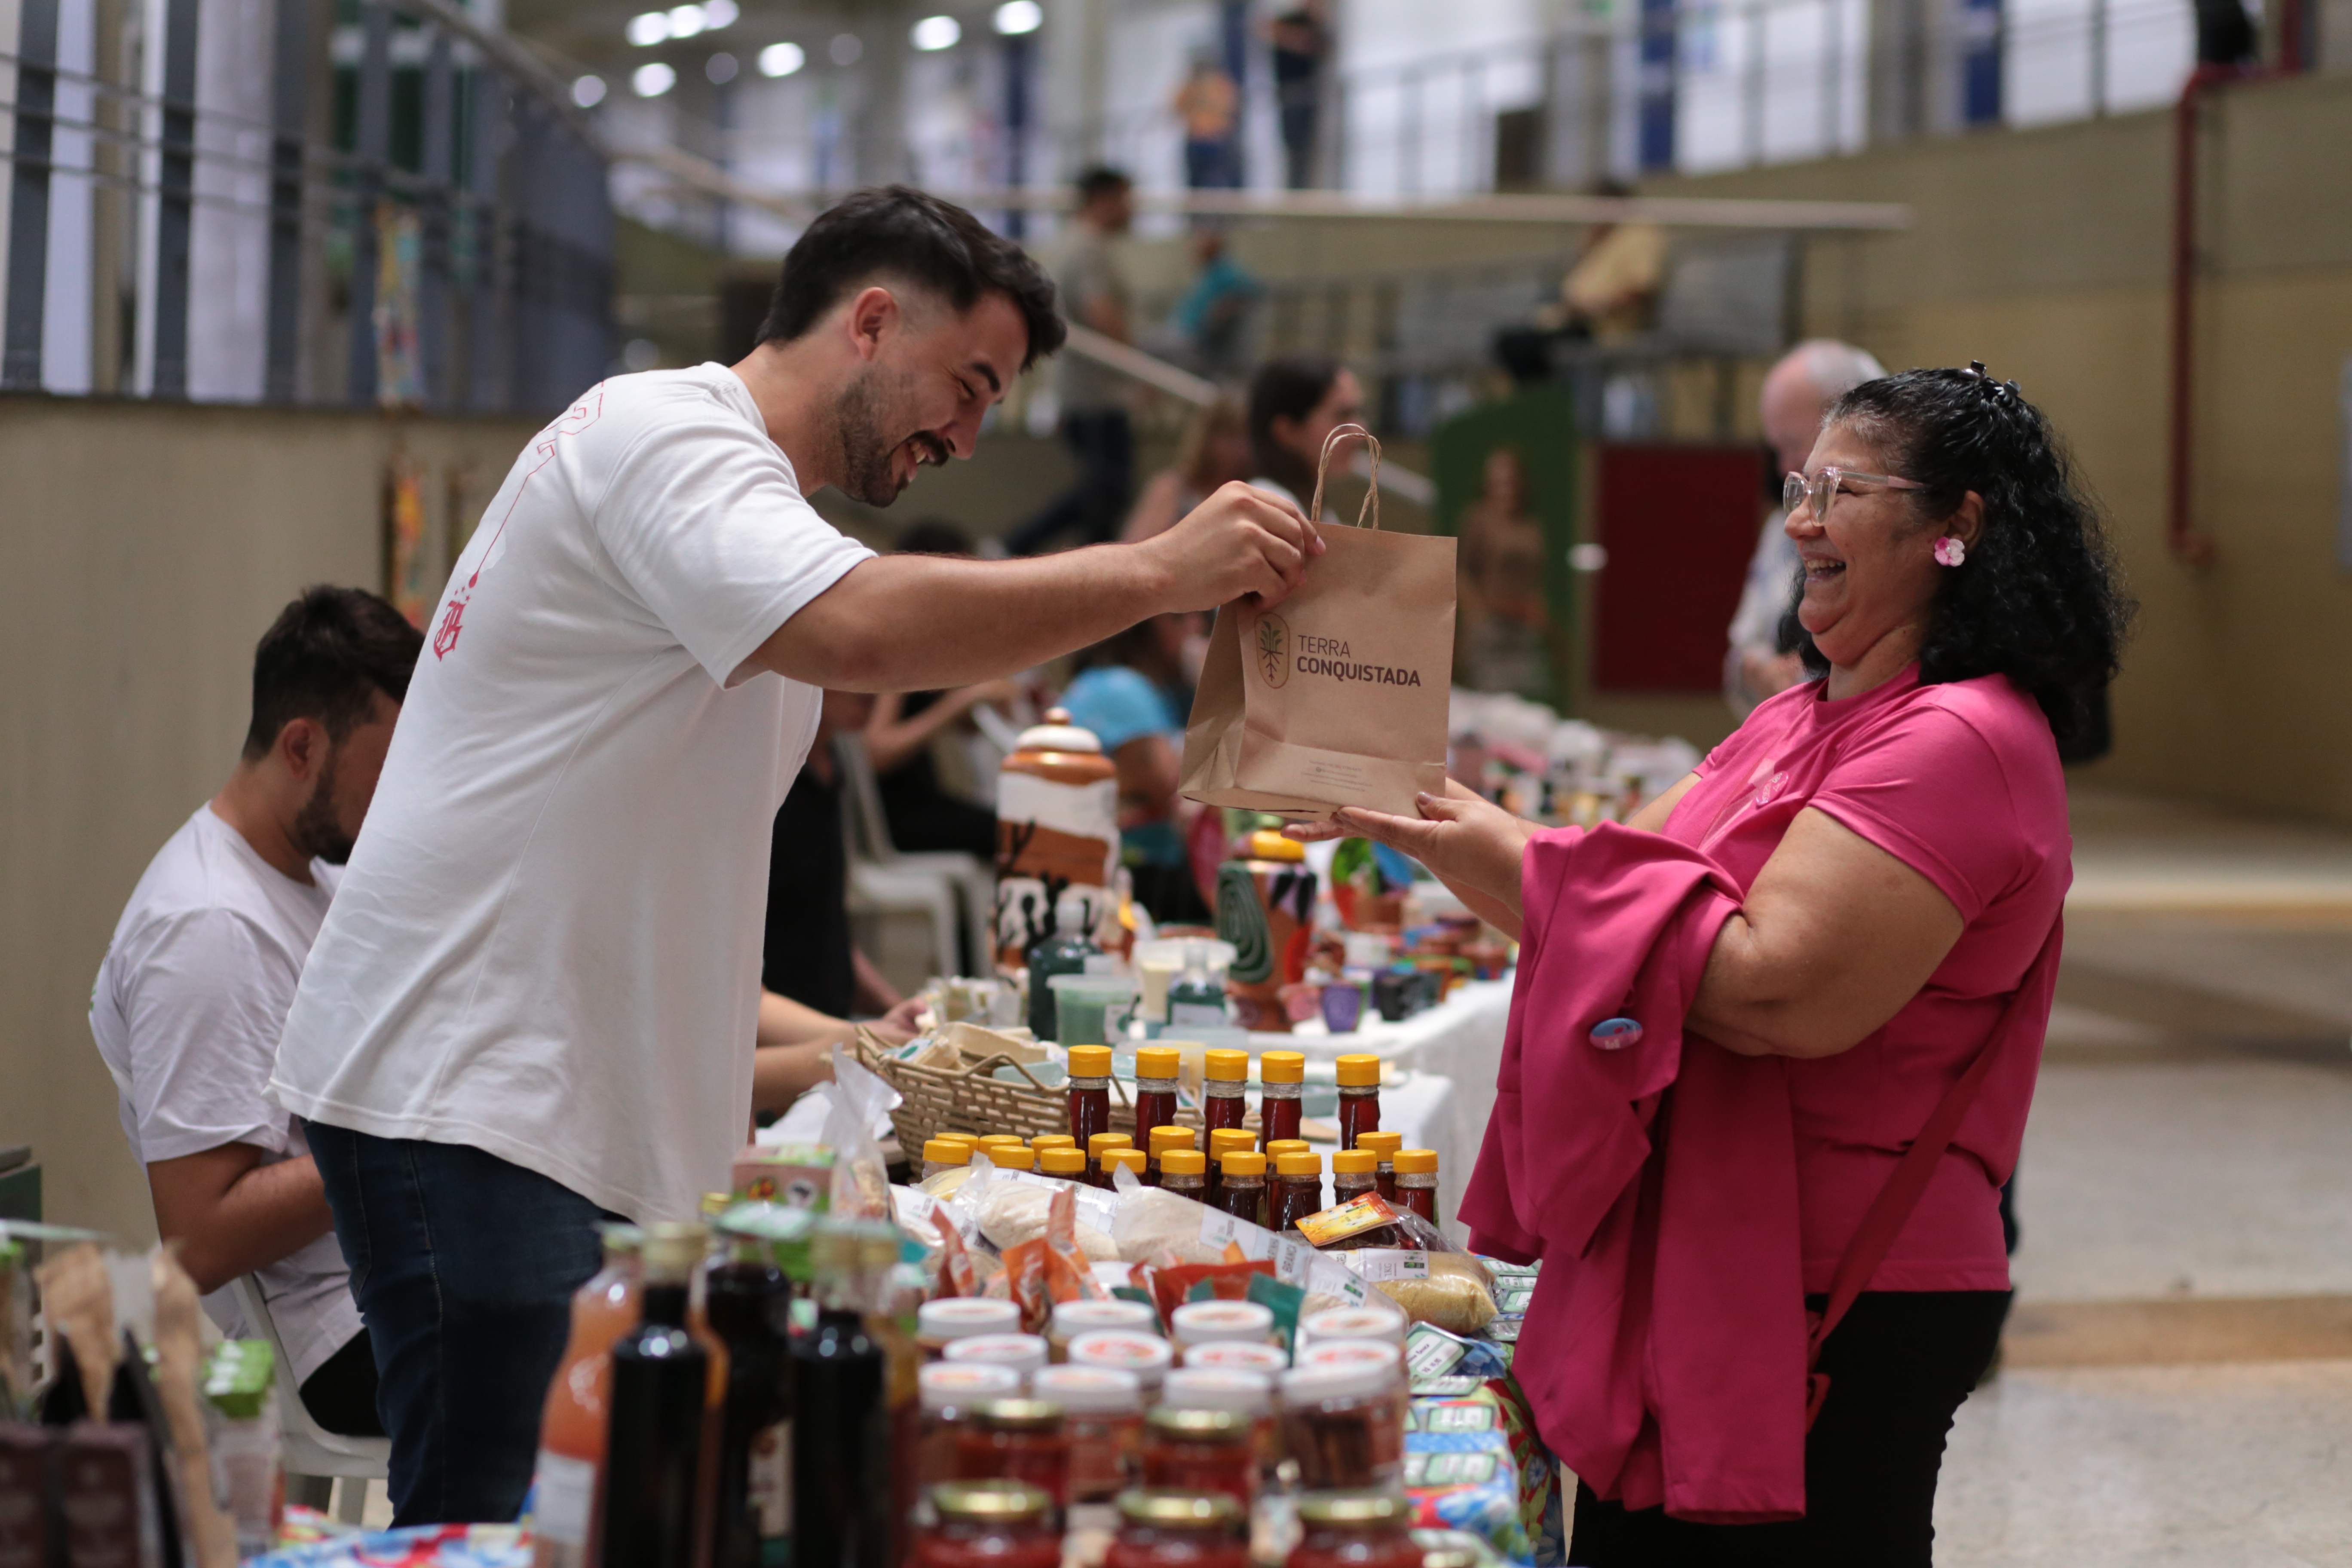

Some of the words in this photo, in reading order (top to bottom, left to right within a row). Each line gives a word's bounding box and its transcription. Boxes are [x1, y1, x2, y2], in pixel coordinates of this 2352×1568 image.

[1298, 634, 1351, 658] TERRA
[1297, 656, 1421, 687] CONQUISTADA
[1384, 1263, 1392, 1277] 1KG
